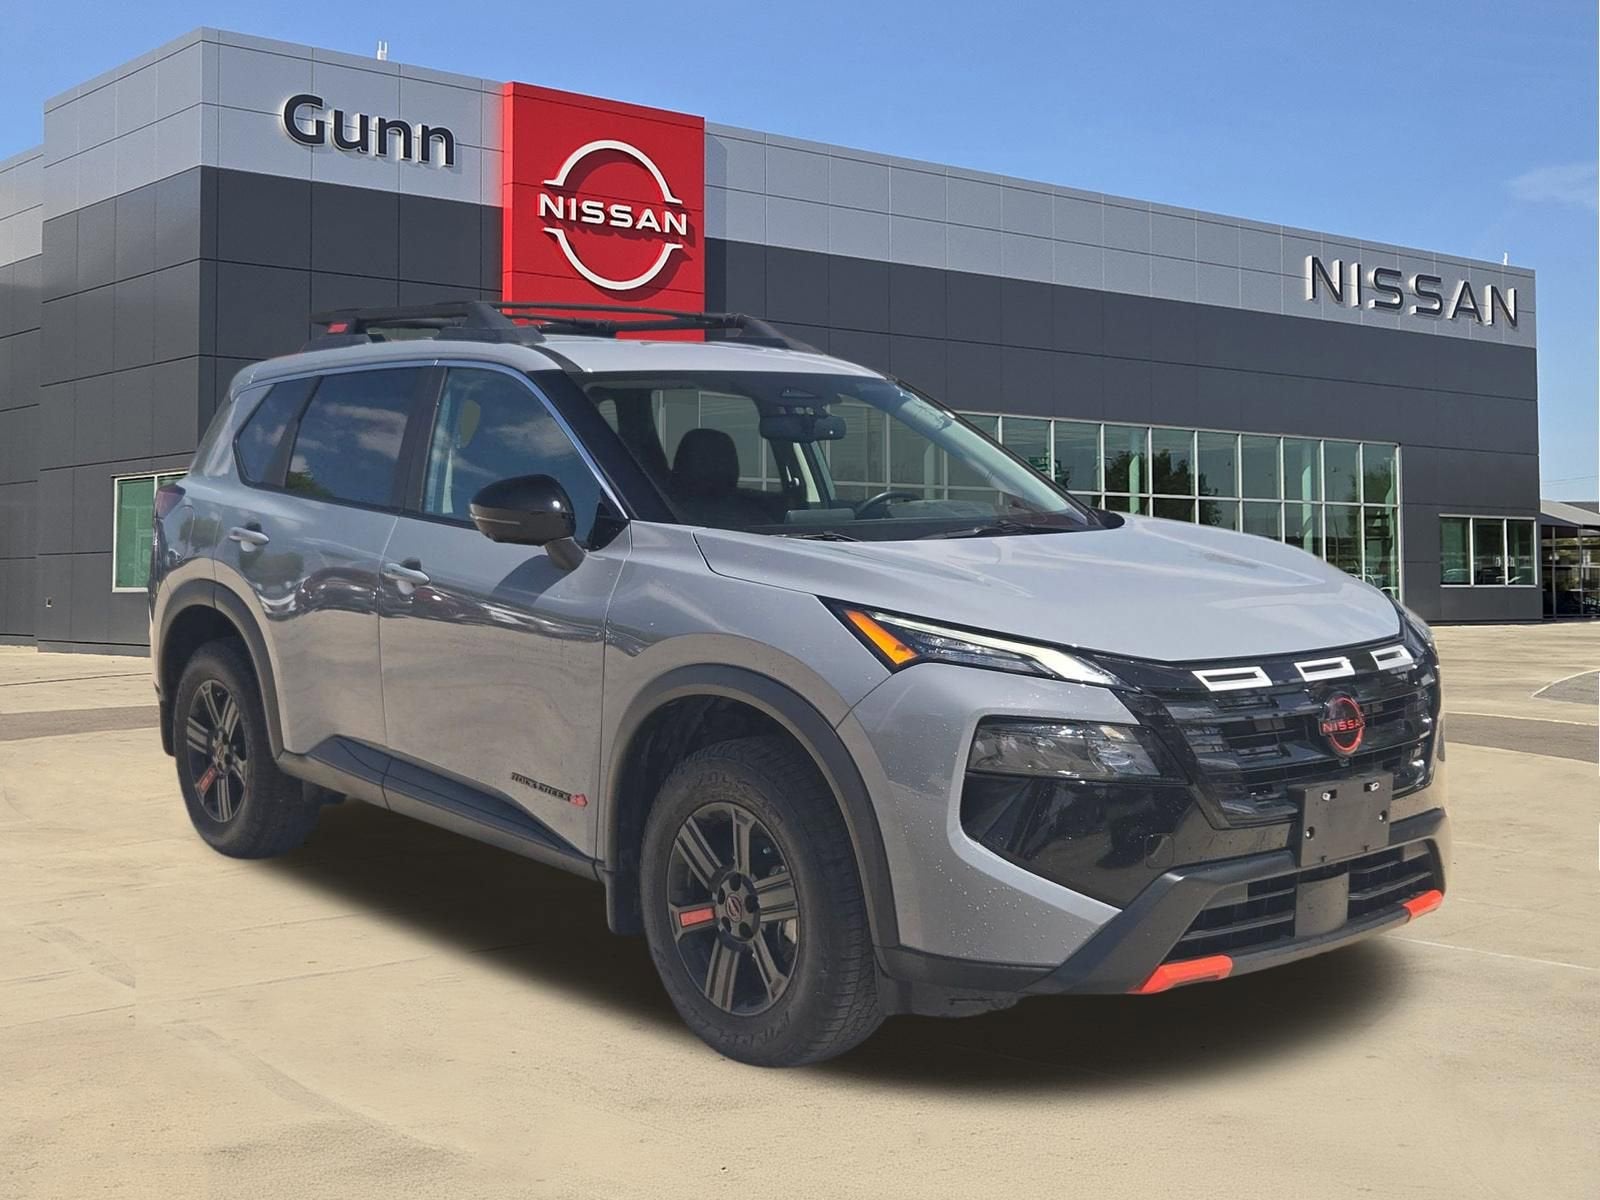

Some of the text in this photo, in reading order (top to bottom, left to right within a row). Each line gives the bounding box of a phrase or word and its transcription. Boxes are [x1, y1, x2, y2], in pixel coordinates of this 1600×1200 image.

[283, 93, 455, 167] Gunn
[538, 192, 687, 236] NISSAN
[1305, 255, 1518, 328] NISSAN
[1322, 719, 1365, 733] NISSA
